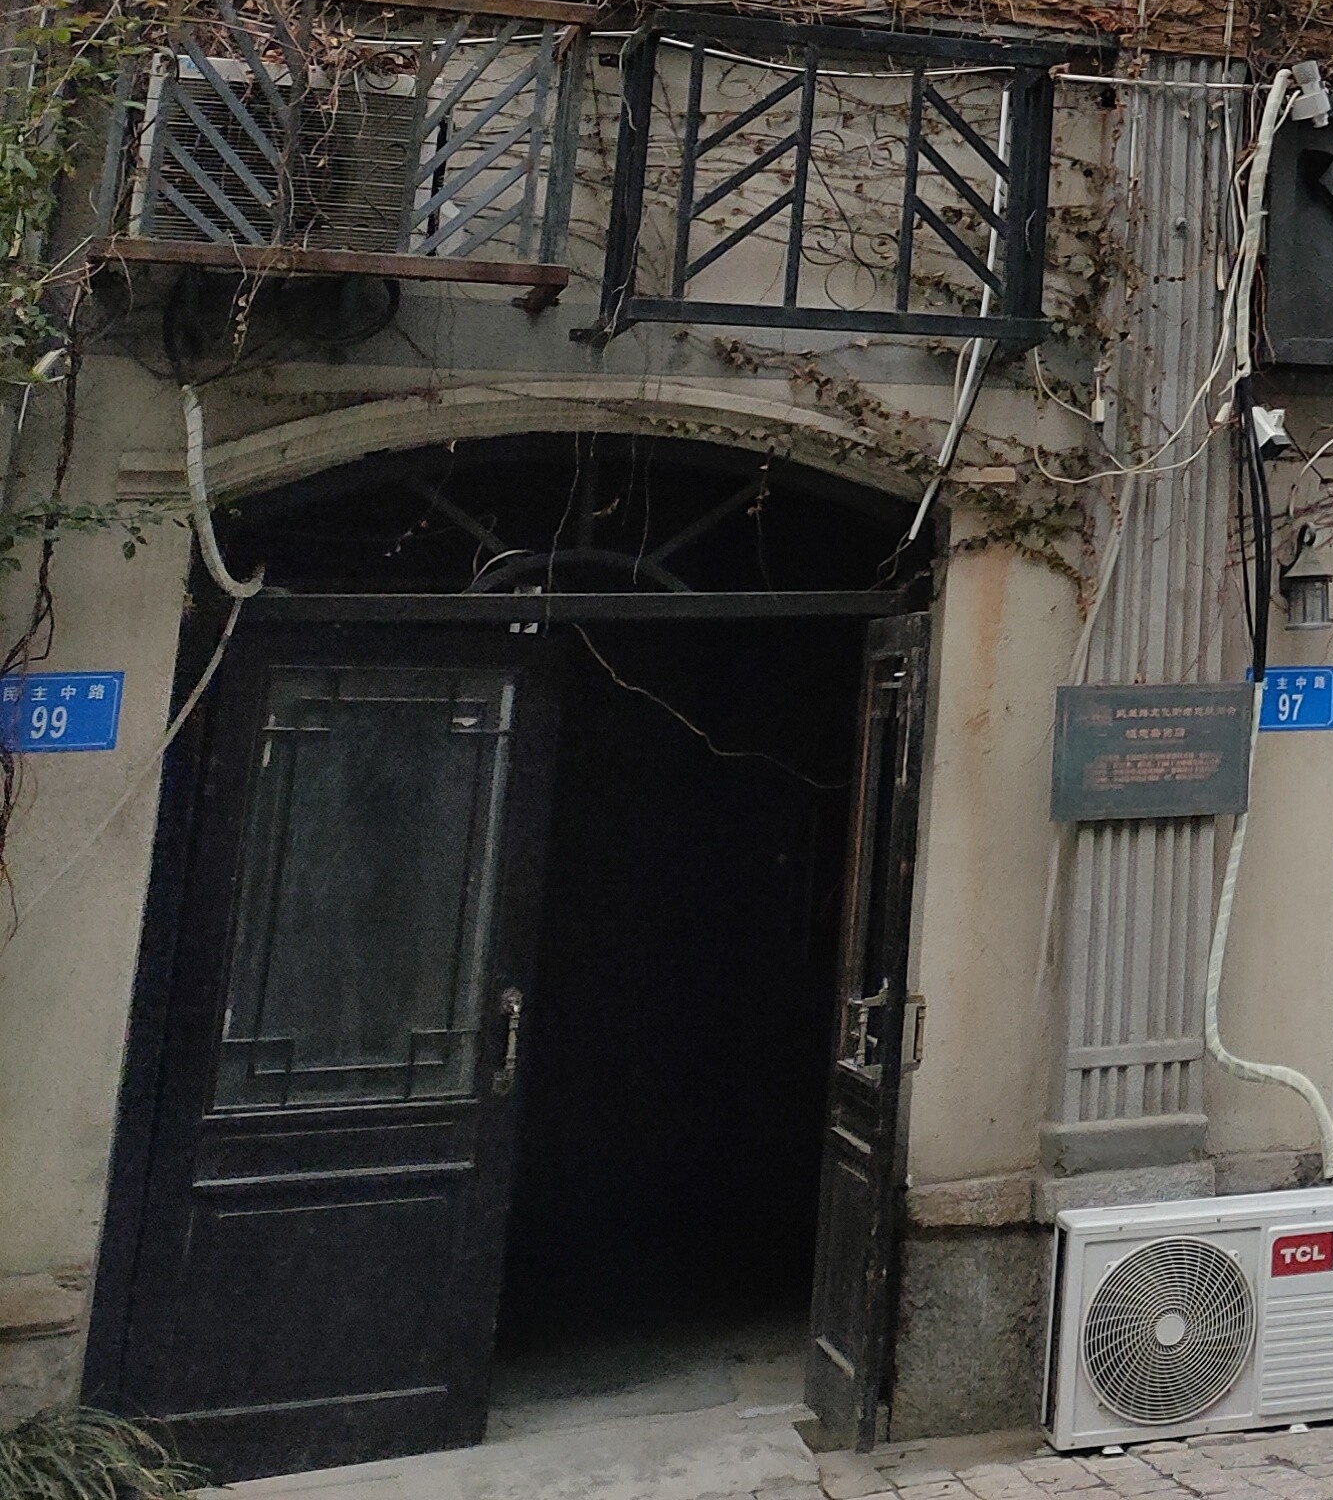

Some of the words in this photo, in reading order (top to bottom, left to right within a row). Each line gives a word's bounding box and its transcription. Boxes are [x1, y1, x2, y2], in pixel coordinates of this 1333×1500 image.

[3, 684, 105, 702] 民主中路
[1278, 693, 1304, 721] 97
[30, 706, 68, 739] 99
[1280, 1245, 1326, 1264] TCL
